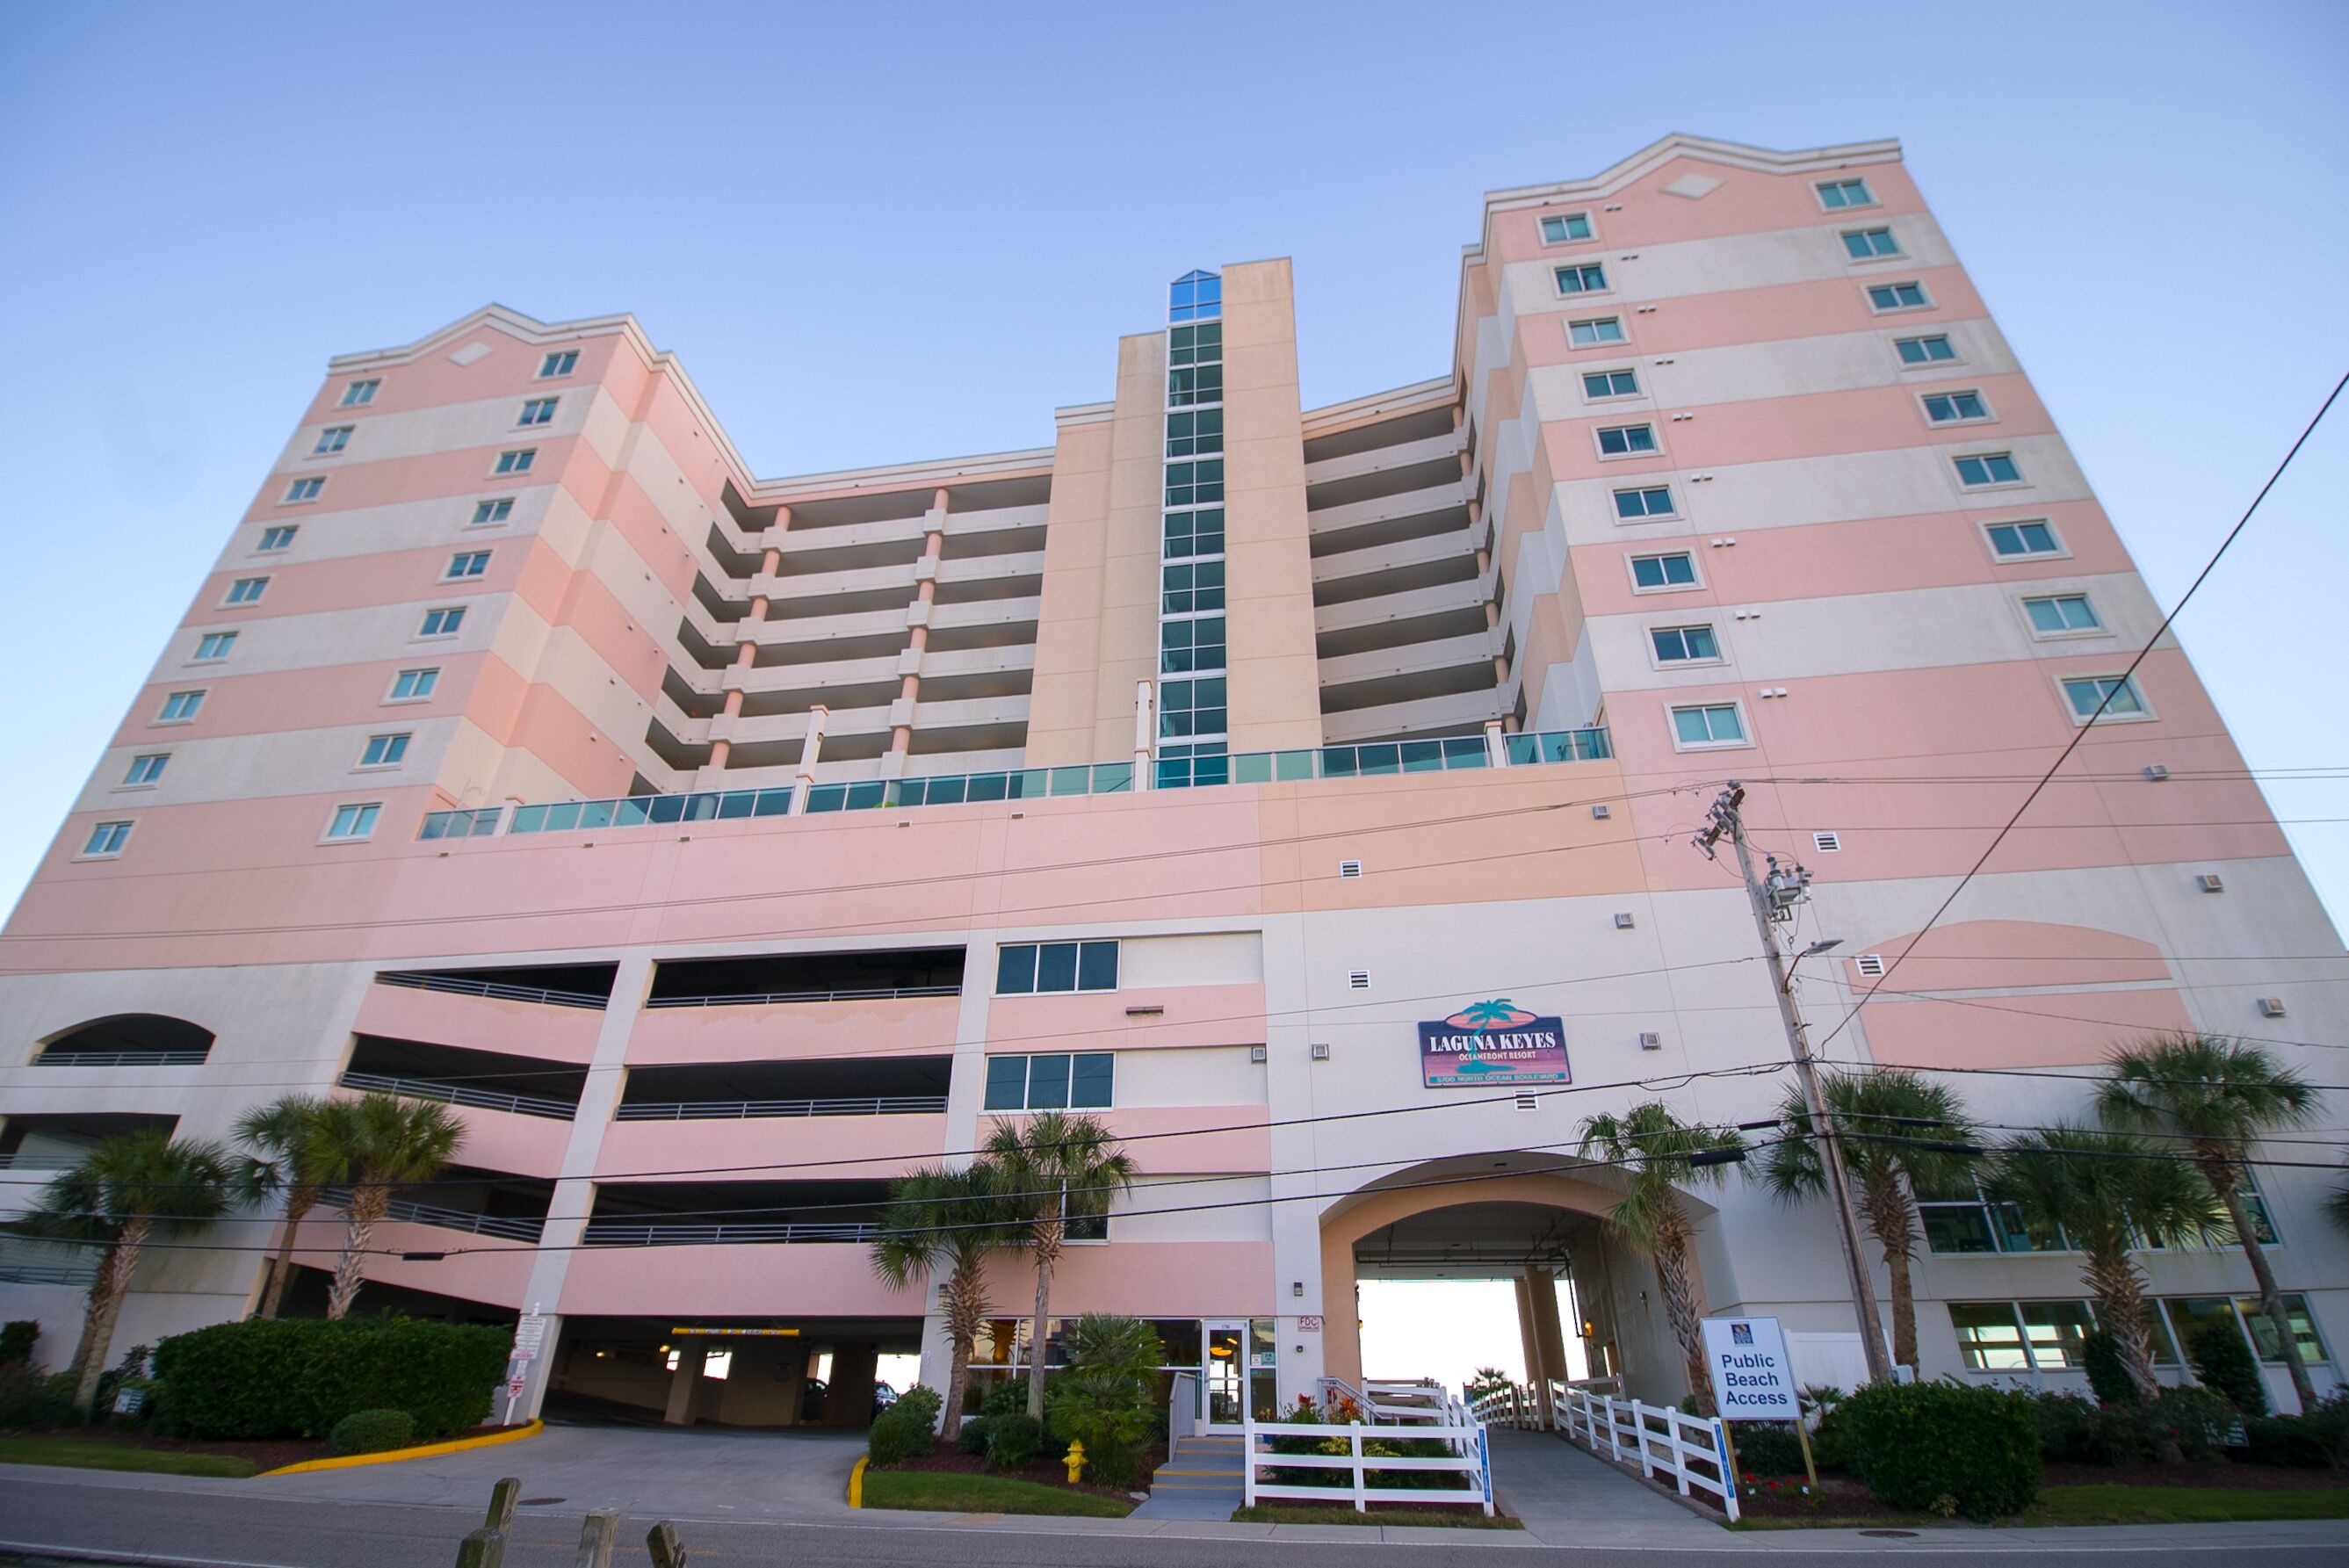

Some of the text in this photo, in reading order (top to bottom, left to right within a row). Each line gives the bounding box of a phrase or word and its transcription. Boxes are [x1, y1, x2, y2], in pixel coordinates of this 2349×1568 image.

[1429, 1031, 1557, 1052] LAGUNA KEYES
[1458, 1051, 1536, 1062] OCEANFRONT RESORT
[1300, 1317, 1318, 1326] FDC
[1721, 1354, 1775, 1369] Public
[1725, 1372, 1779, 1386] Beach
[1725, 1391, 1788, 1405] Access
